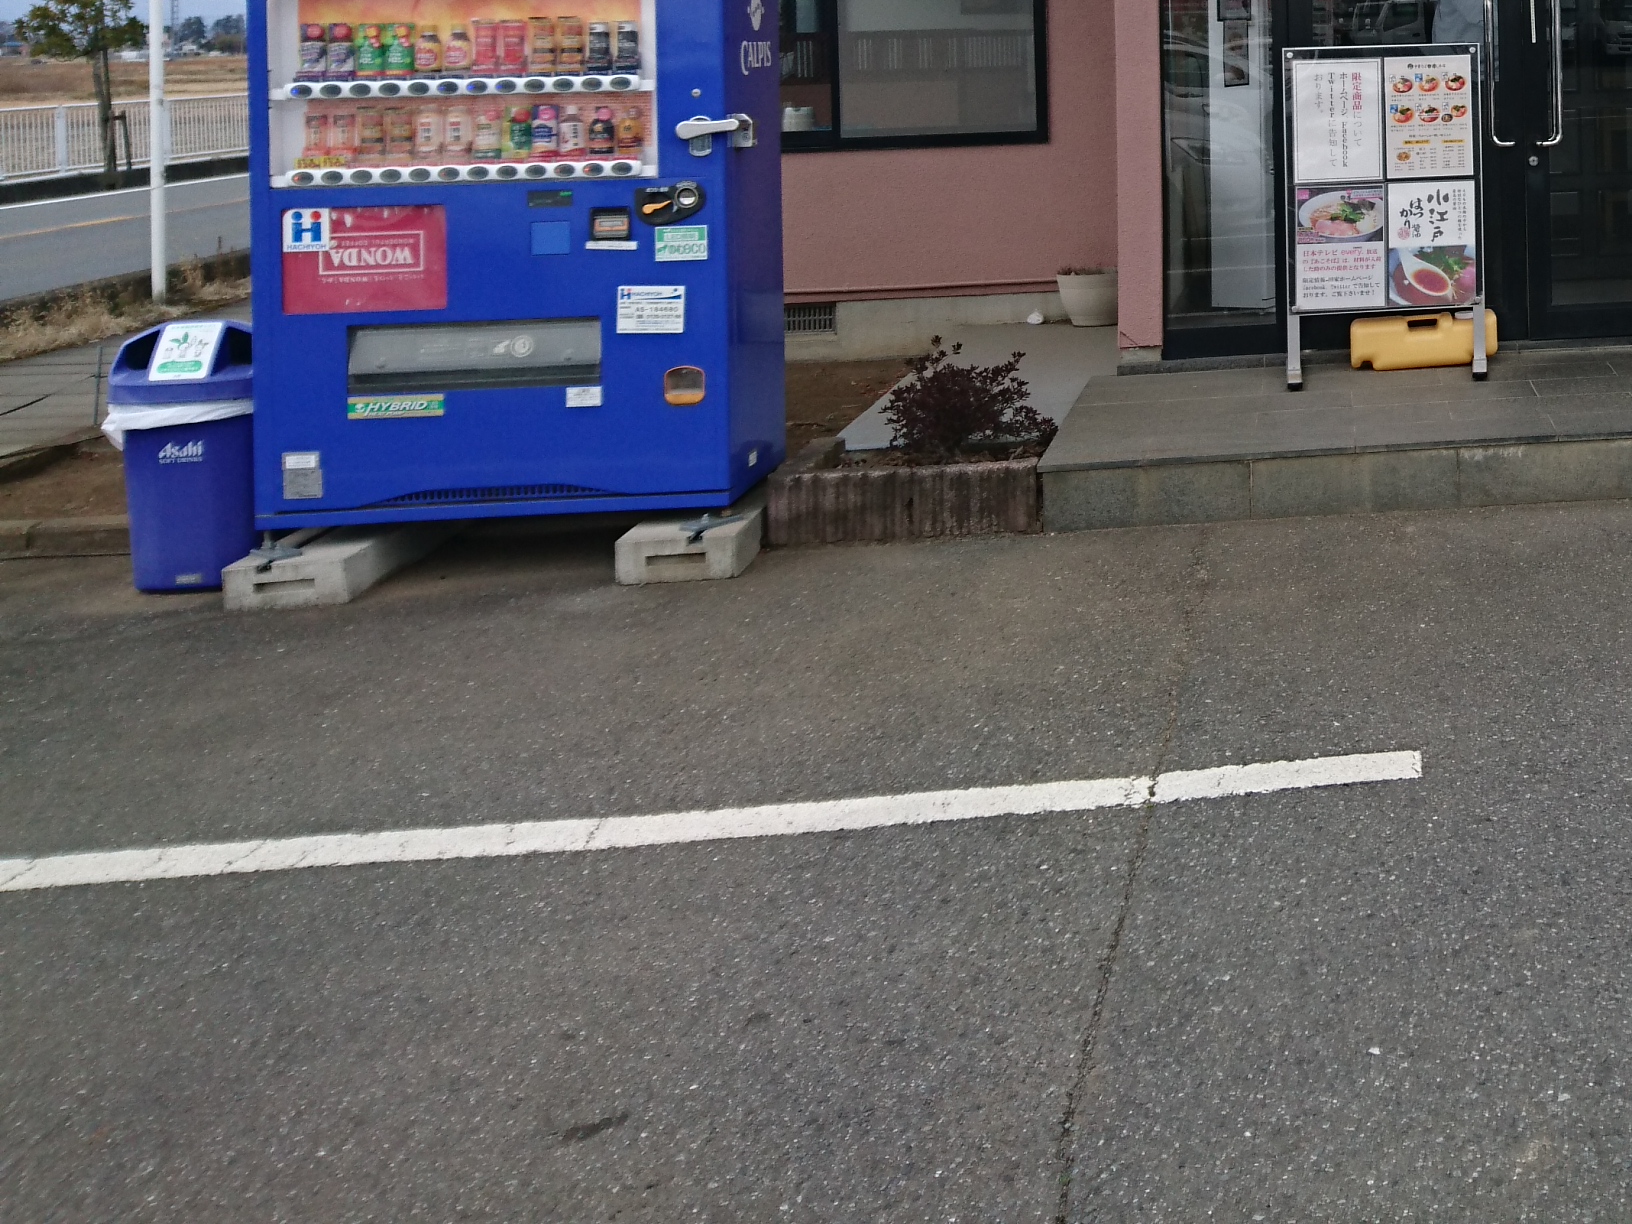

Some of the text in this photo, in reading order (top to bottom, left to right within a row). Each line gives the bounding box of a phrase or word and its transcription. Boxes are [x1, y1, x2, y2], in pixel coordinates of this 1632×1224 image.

[740, 40, 772, 76] CALPIS
[1314, 73, 1324, 114] おります。
[1351, 72, 1362, 147] 限定商品について
[1427, 188, 1450, 243] 小江戸
[328, 247, 414, 267] WONDA
[341, 239, 368, 247] COFFEE
[366, 401, 428, 416] HYBRID
[158, 440, 204, 458] Asahi
